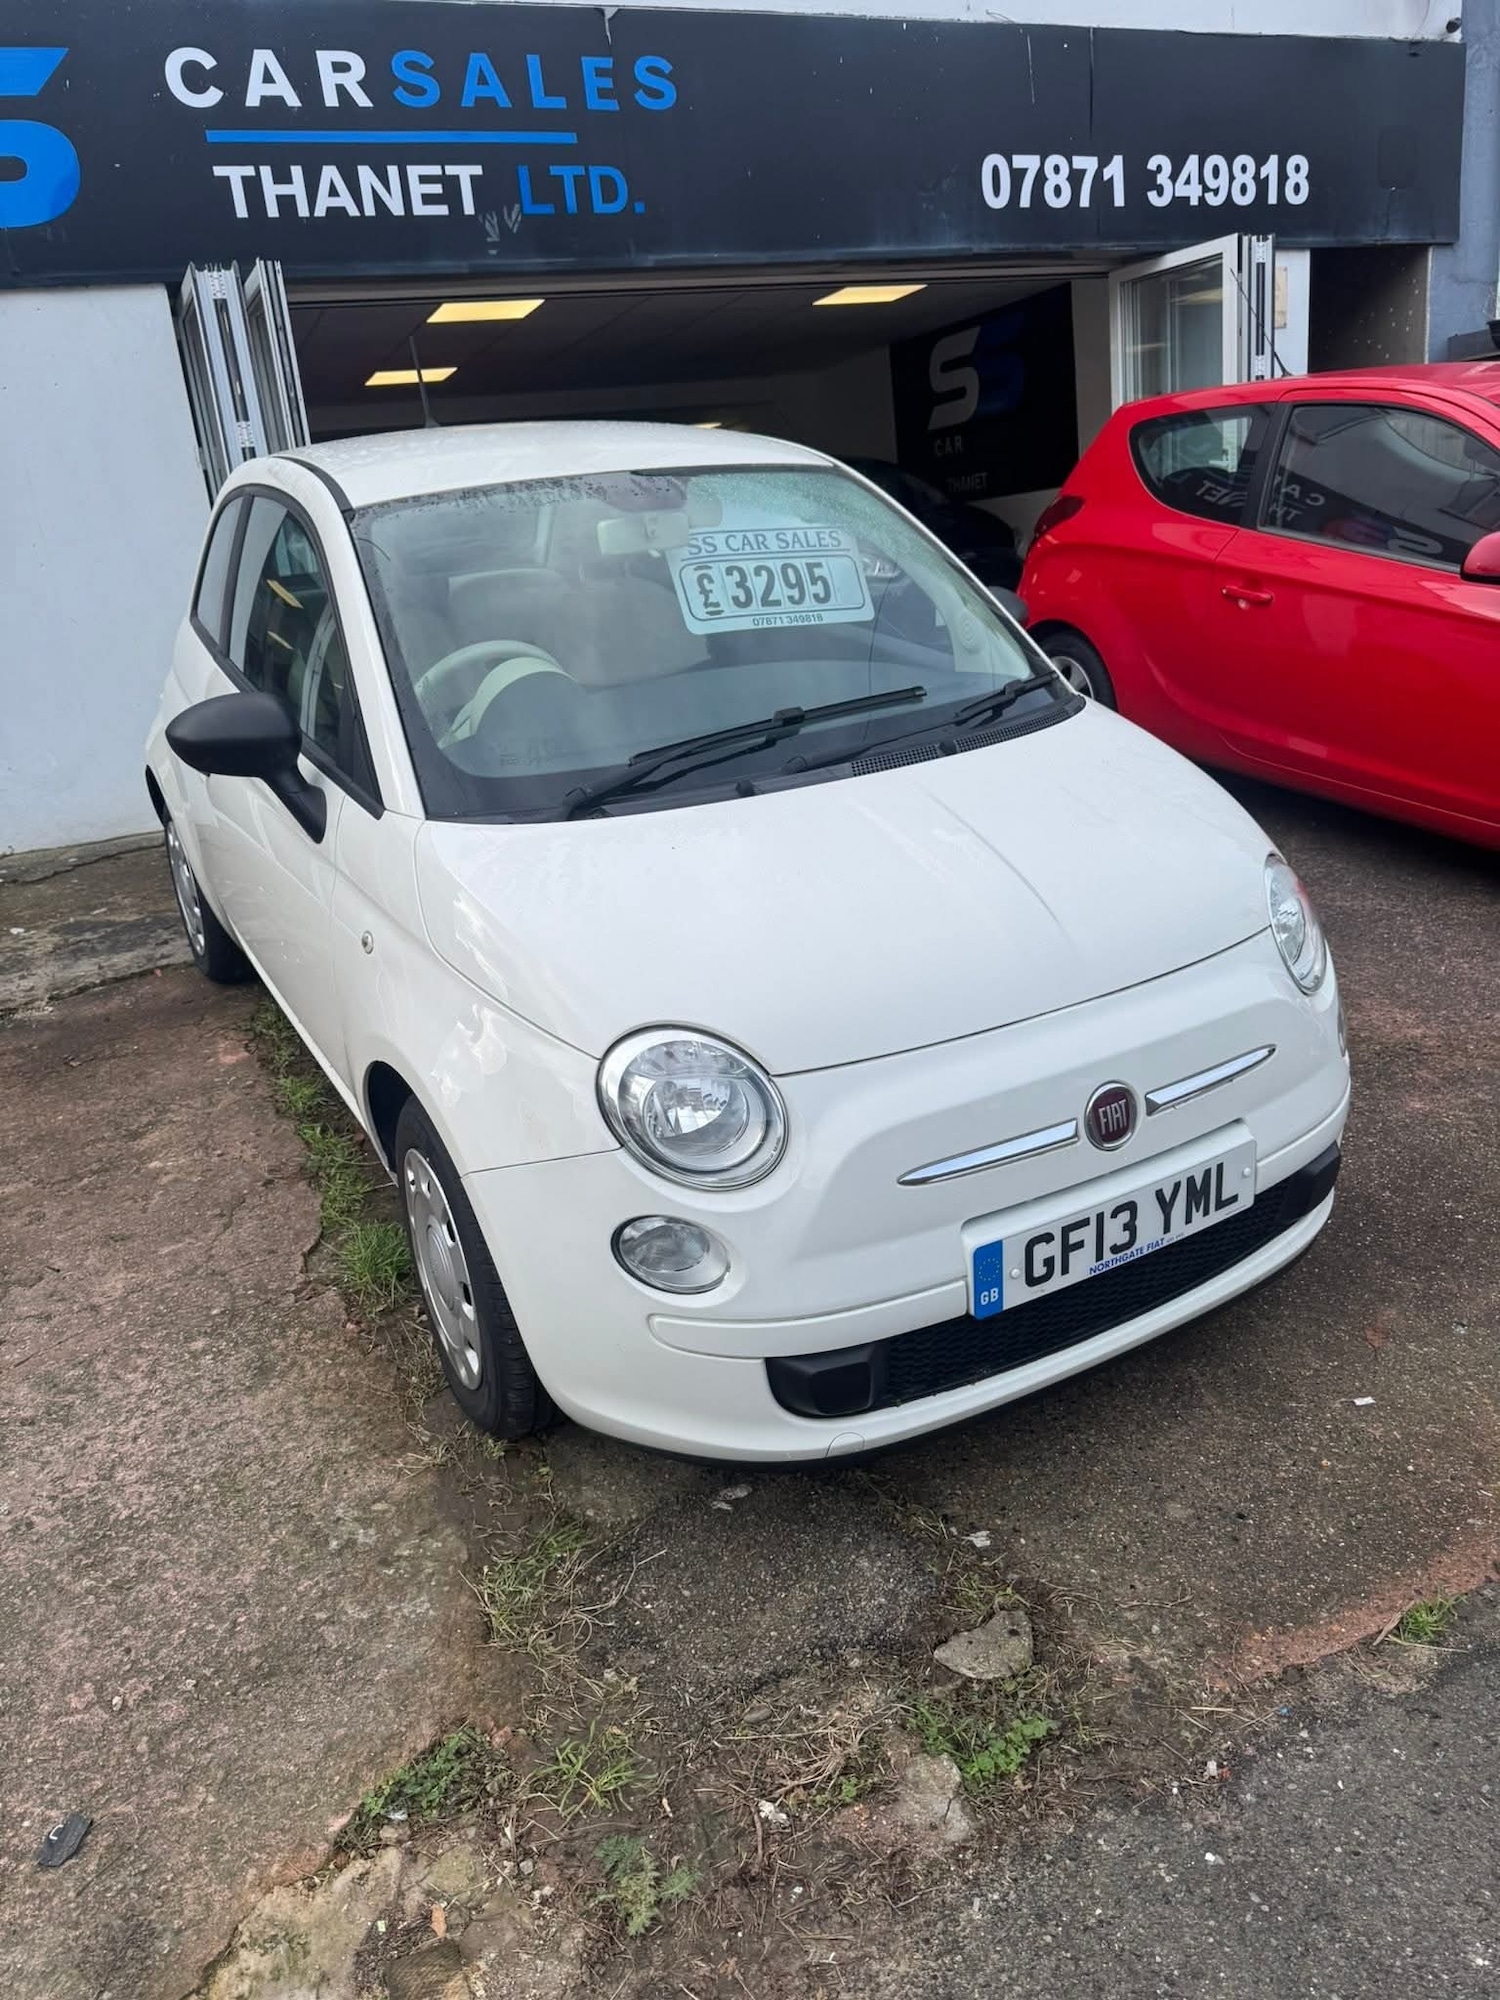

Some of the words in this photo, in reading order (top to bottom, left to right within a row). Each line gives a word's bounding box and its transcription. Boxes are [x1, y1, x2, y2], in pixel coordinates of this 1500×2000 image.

[212, 164, 484, 219] THANET
[517, 164, 646, 215] LTD.
[981, 153, 1125, 209] 07871
[1146, 154, 1310, 208] 349818
[688, 536, 718, 555] SS
[725, 533, 769, 552] CAR
[775, 530, 842, 551] SALES
[693, 561, 832, 617] £3295
[752, 614, 785, 627] 07871
[1098, 1099, 1129, 1135] FIAT
[1024, 1200, 1138, 1288] GF13
[1154, 1161, 1240, 1235] YML
[1088, 1246, 1145, 1276] NORTHGATE
[1145, 1237, 1166, 1253] FIAT
[979, 1286, 1000, 1306] GB
